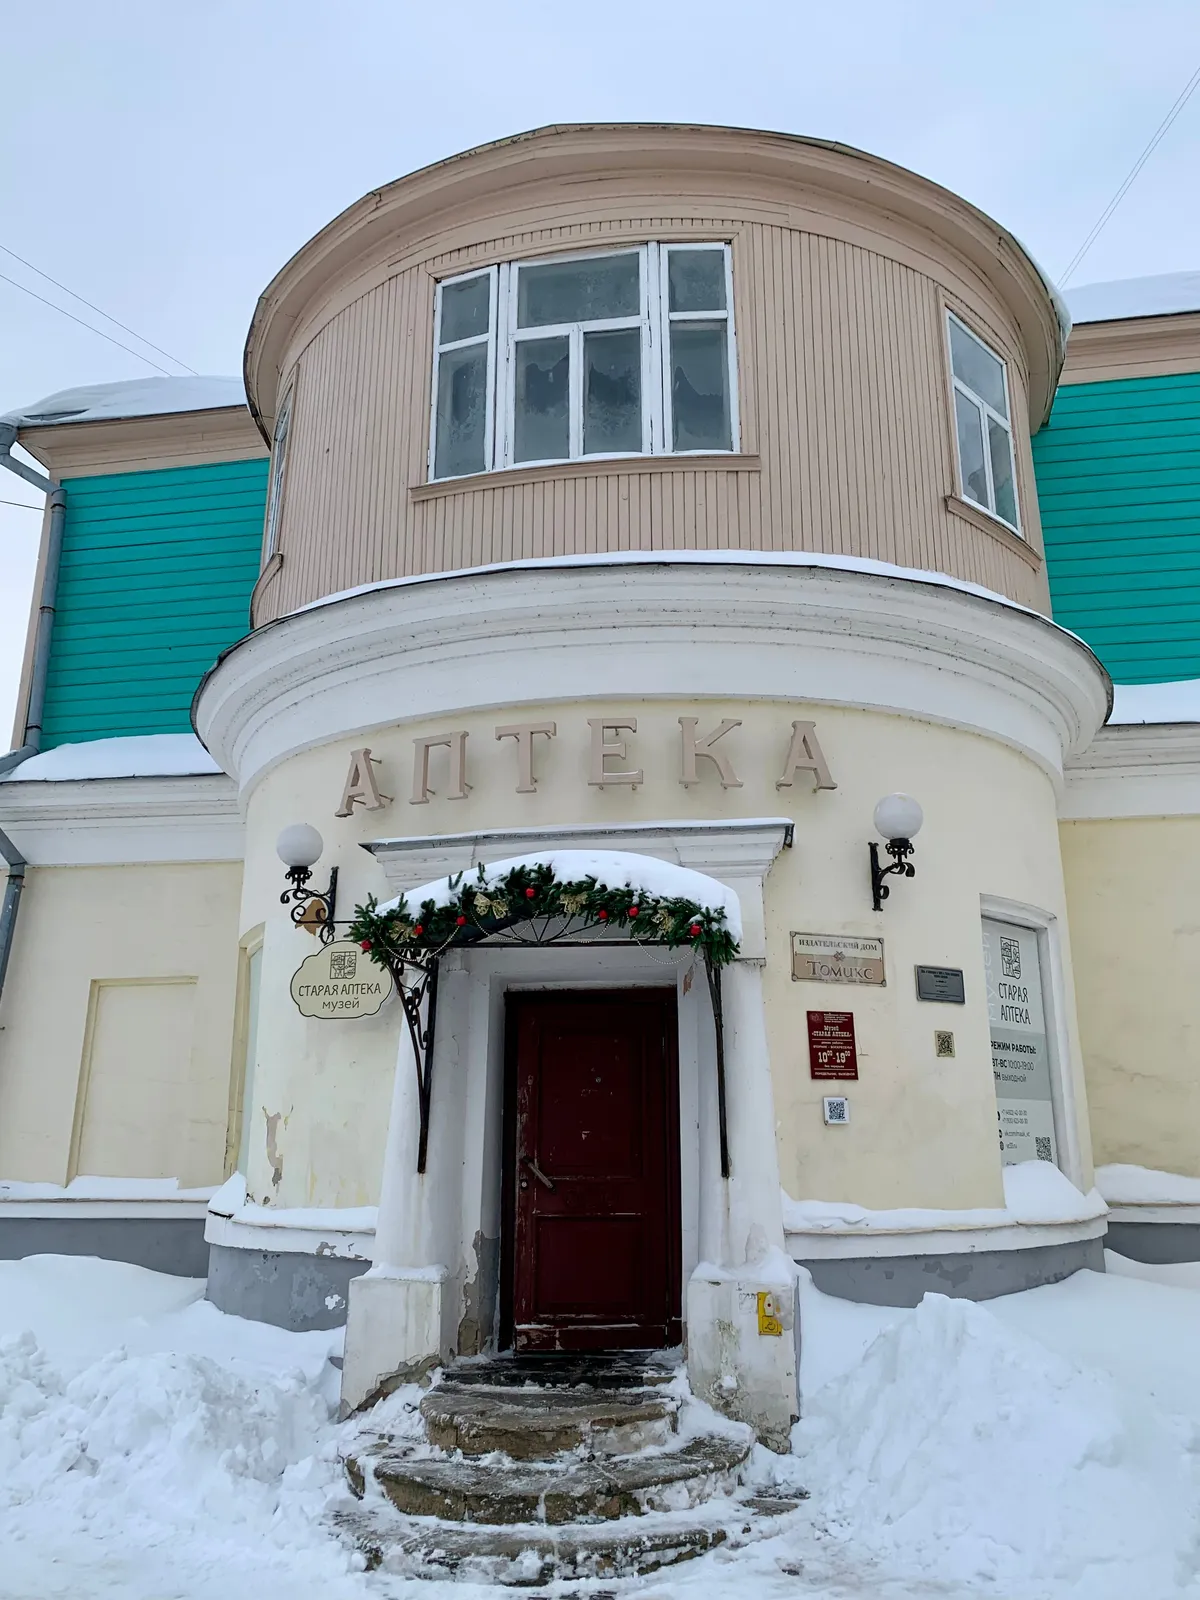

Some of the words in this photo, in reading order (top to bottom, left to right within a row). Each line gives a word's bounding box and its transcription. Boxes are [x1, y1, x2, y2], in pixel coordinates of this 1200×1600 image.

[334, 716, 838, 818] АПТЕКА
[799, 939, 859, 950] ИЗДАТЕЛЬСКИЙ
[860, 943, 877, 951] ДОМ
[298, 984, 339, 997] СТАРАЯ
[340, 982, 382, 996] АПТЕКА
[998, 982, 1029, 1004] СТАРАЯ
[322, 997, 360, 1012] музей
[1000, 1004, 1032, 1025] АПТЕКА
